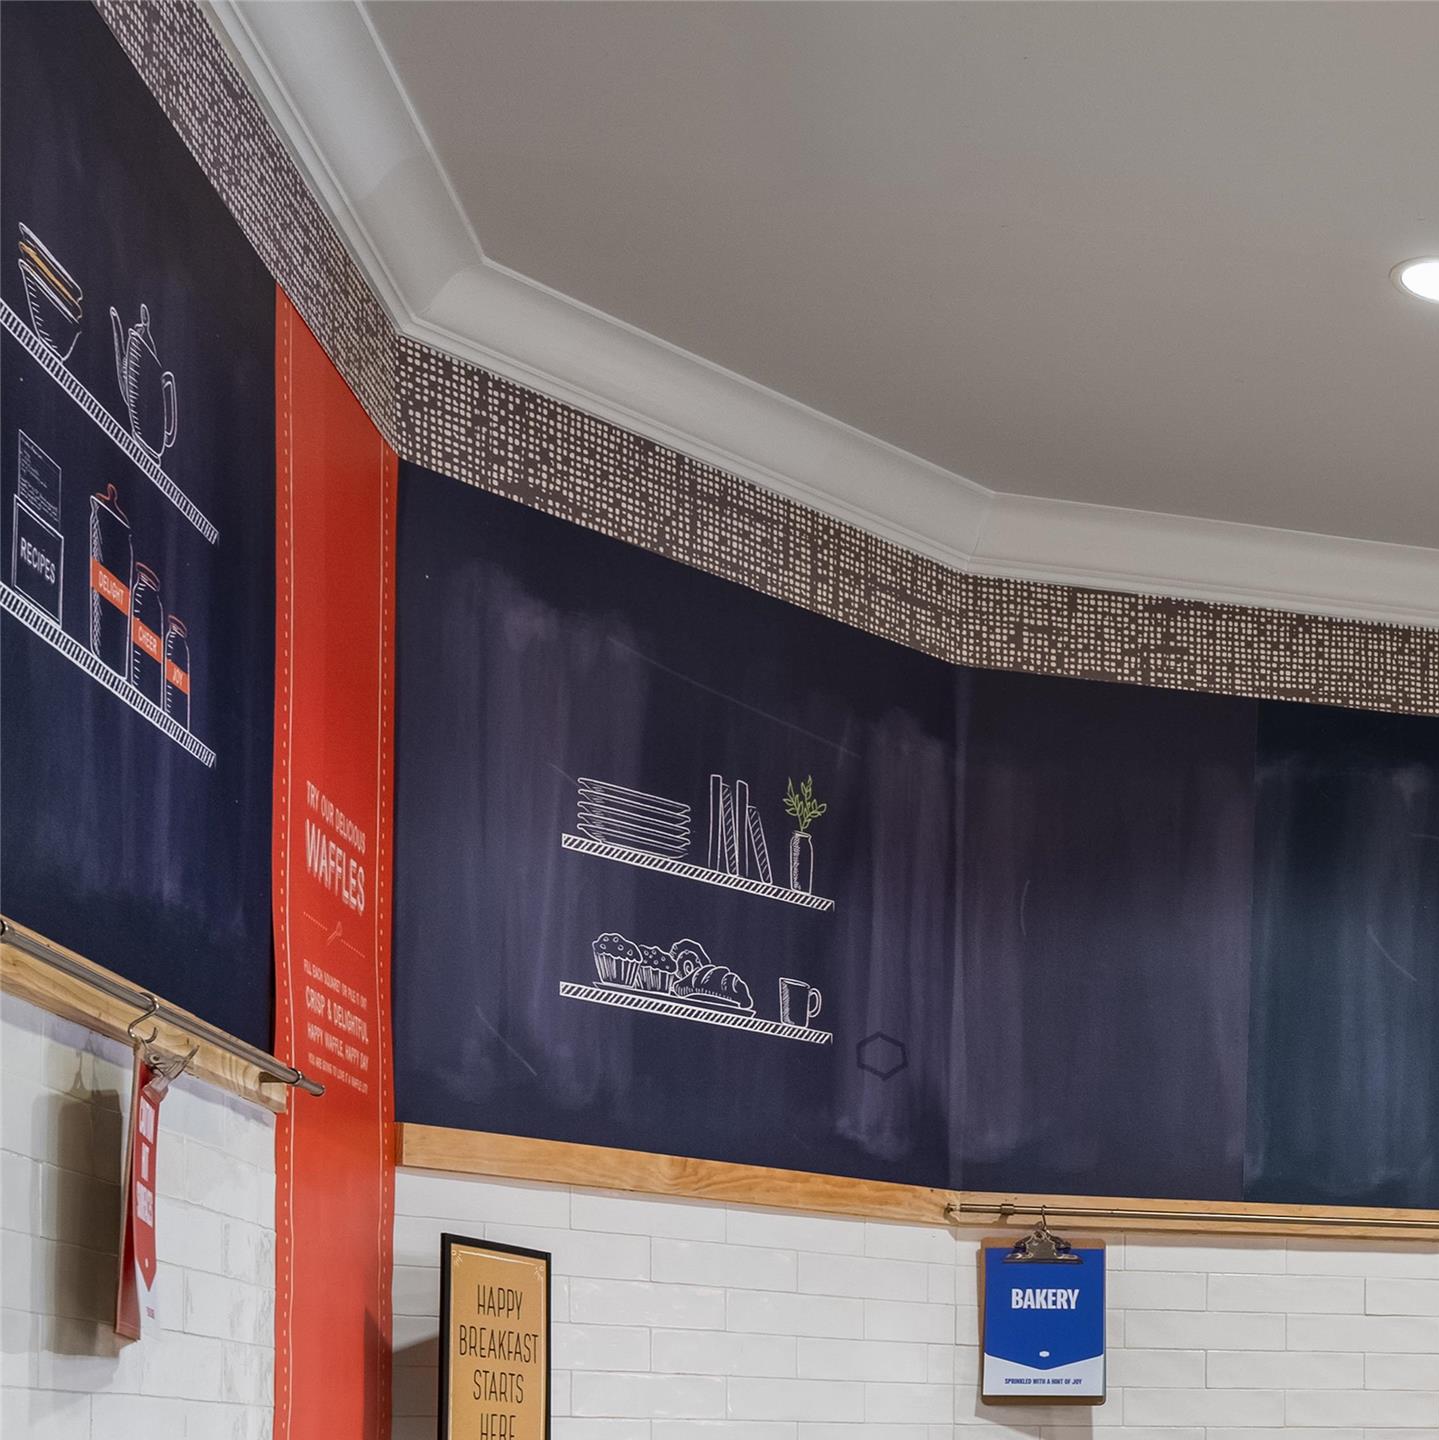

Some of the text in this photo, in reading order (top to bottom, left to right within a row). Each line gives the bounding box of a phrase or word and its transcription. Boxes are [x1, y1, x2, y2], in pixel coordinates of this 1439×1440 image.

[20, 537, 56, 584] RECIPES
[99, 571, 124, 606] DELIGHT
[138, 626, 157, 652] CHEER
[172, 664, 183, 686] JOY
[306, 780, 366, 856] TRY OUR DELICIOUS
[305, 818, 365, 917] WAFFLES
[305, 985, 369, 1045] CRISP & DELIGHTFUL
[477, 1284, 523, 1320] HAPPY
[1011, 1288, 1080, 1310] BAKERY
[459, 1324, 539, 1364] BREAKFAST
[472, 1368, 524, 1404] STARTS
